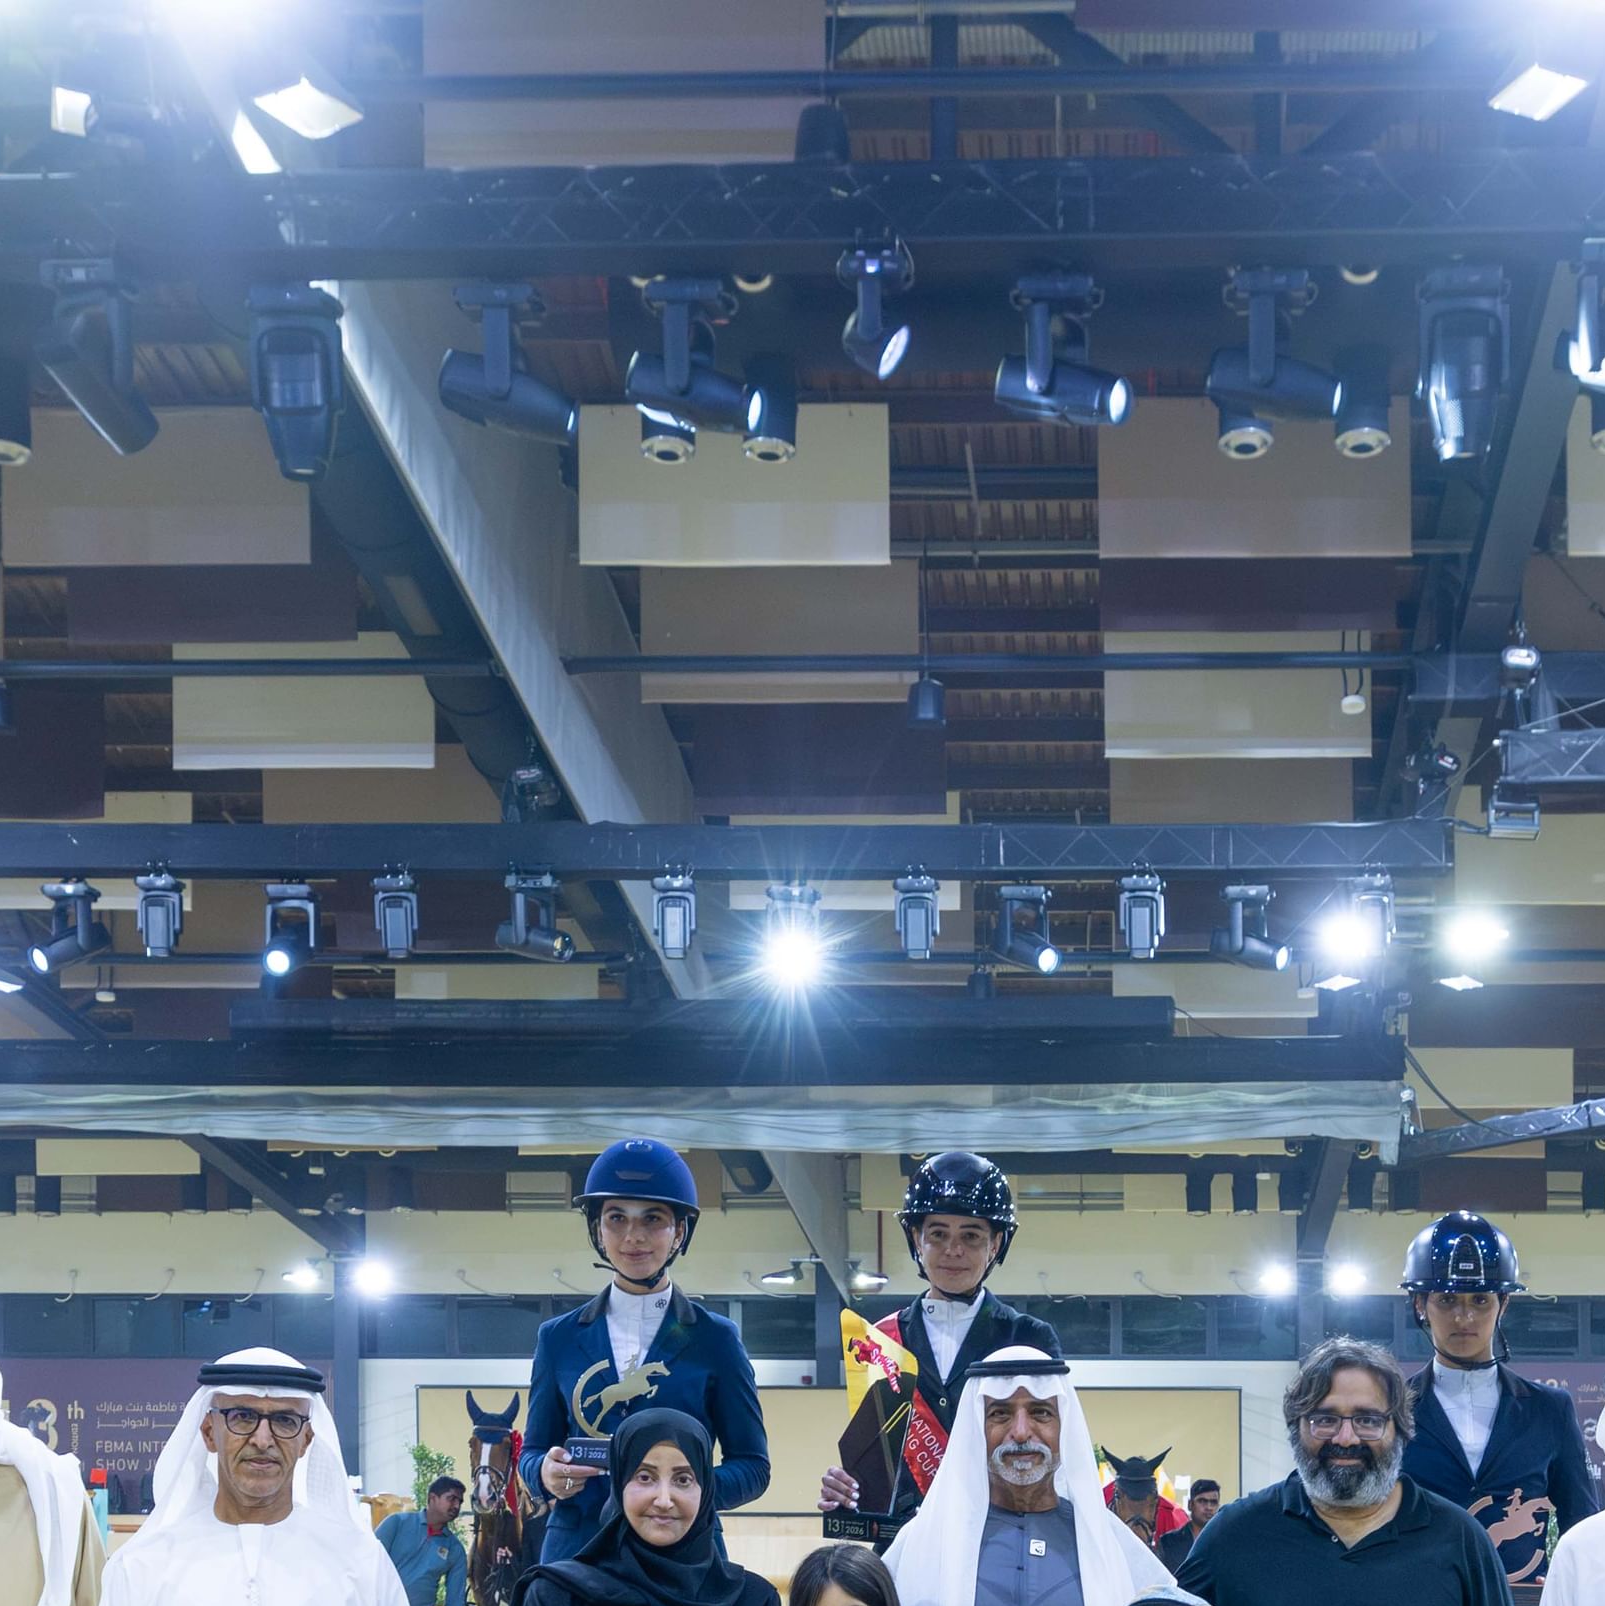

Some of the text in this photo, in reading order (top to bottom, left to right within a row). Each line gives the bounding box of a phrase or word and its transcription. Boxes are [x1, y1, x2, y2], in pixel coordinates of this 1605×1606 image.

[95, 1401, 123, 1414] مبارك
[125, 1401, 143, 1412] بنت
[145, 1401, 177, 1412] فاطمة
[95, 1440, 134, 1453] FBMA
[95, 1458, 140, 1471] SHOW
[845, 1526, 865, 1535] 2026
